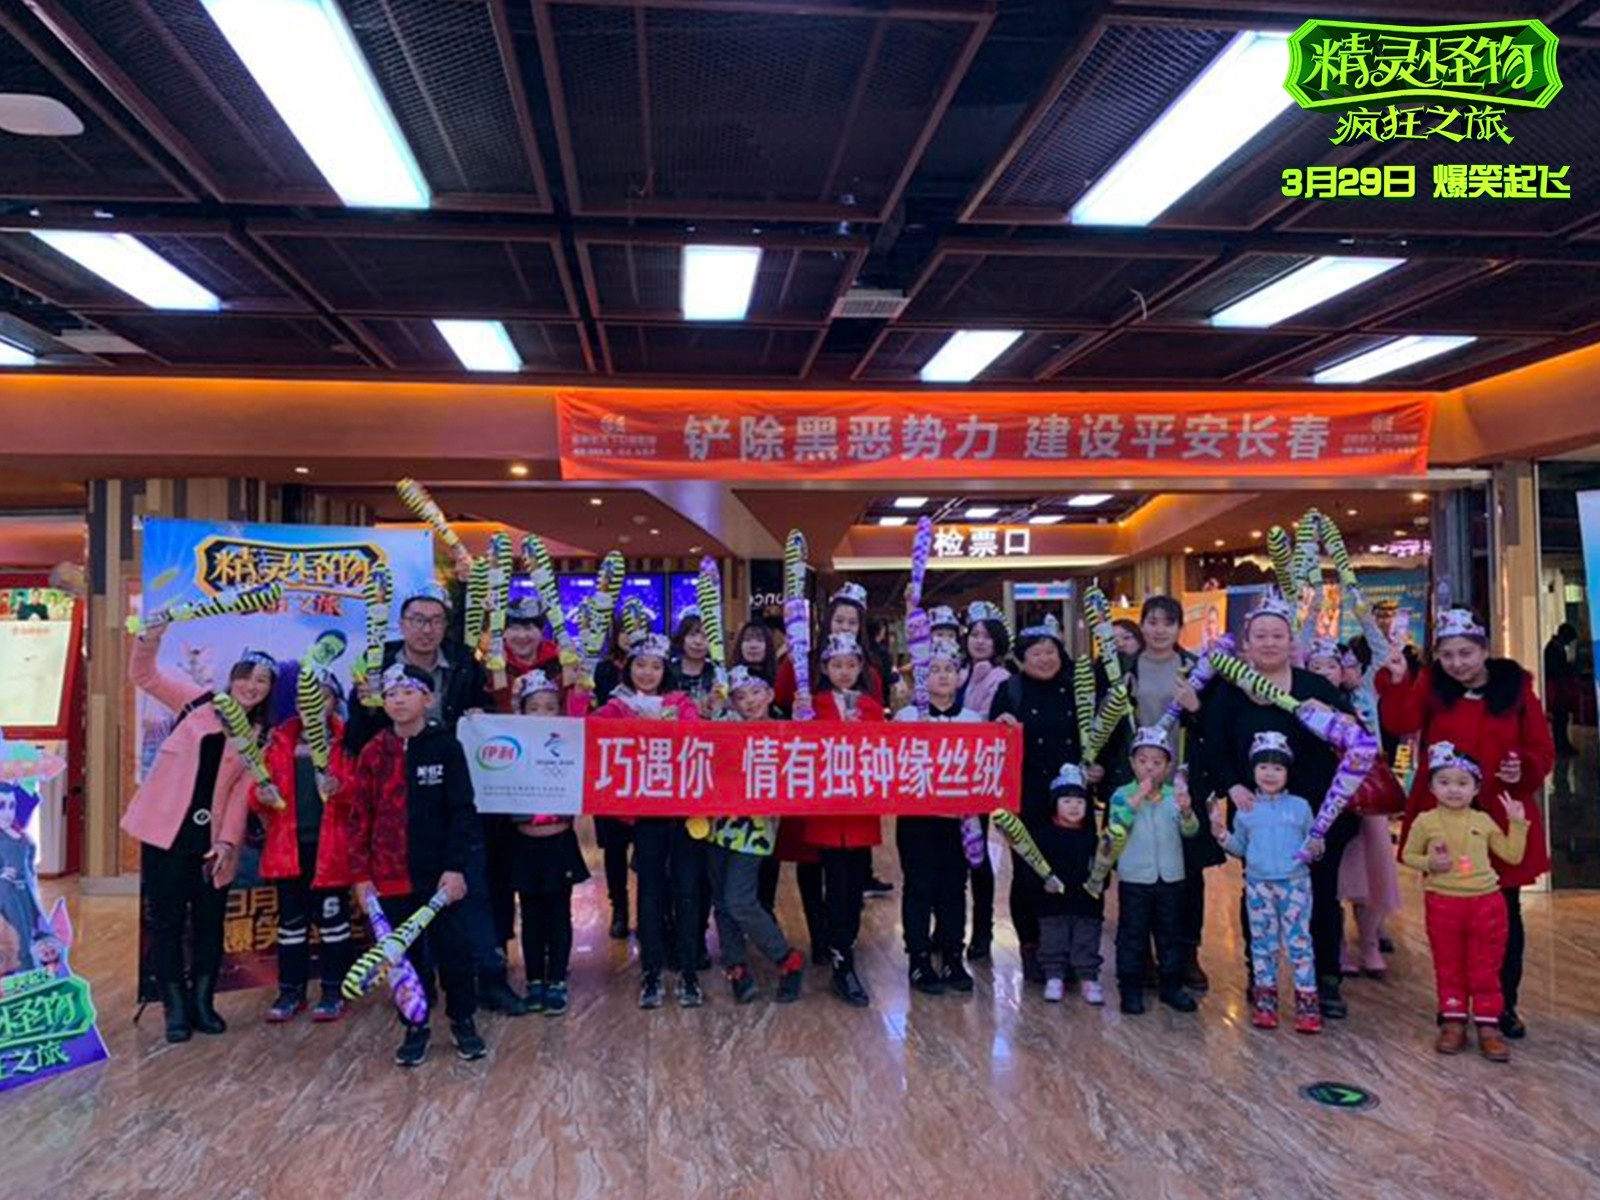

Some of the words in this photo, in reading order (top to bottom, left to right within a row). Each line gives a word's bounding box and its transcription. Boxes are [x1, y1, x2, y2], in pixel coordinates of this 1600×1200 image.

[684, 413, 999, 461] 铲除黑恶势力
[1022, 413, 1331, 460] 建设平安长春
[933, 527, 1030, 557] 检票口
[209, 547, 371, 588] 精灵怪物
[595, 736, 715, 799] 巧遇你
[741, 736, 1007, 799] 情有独钟缘丝绒
